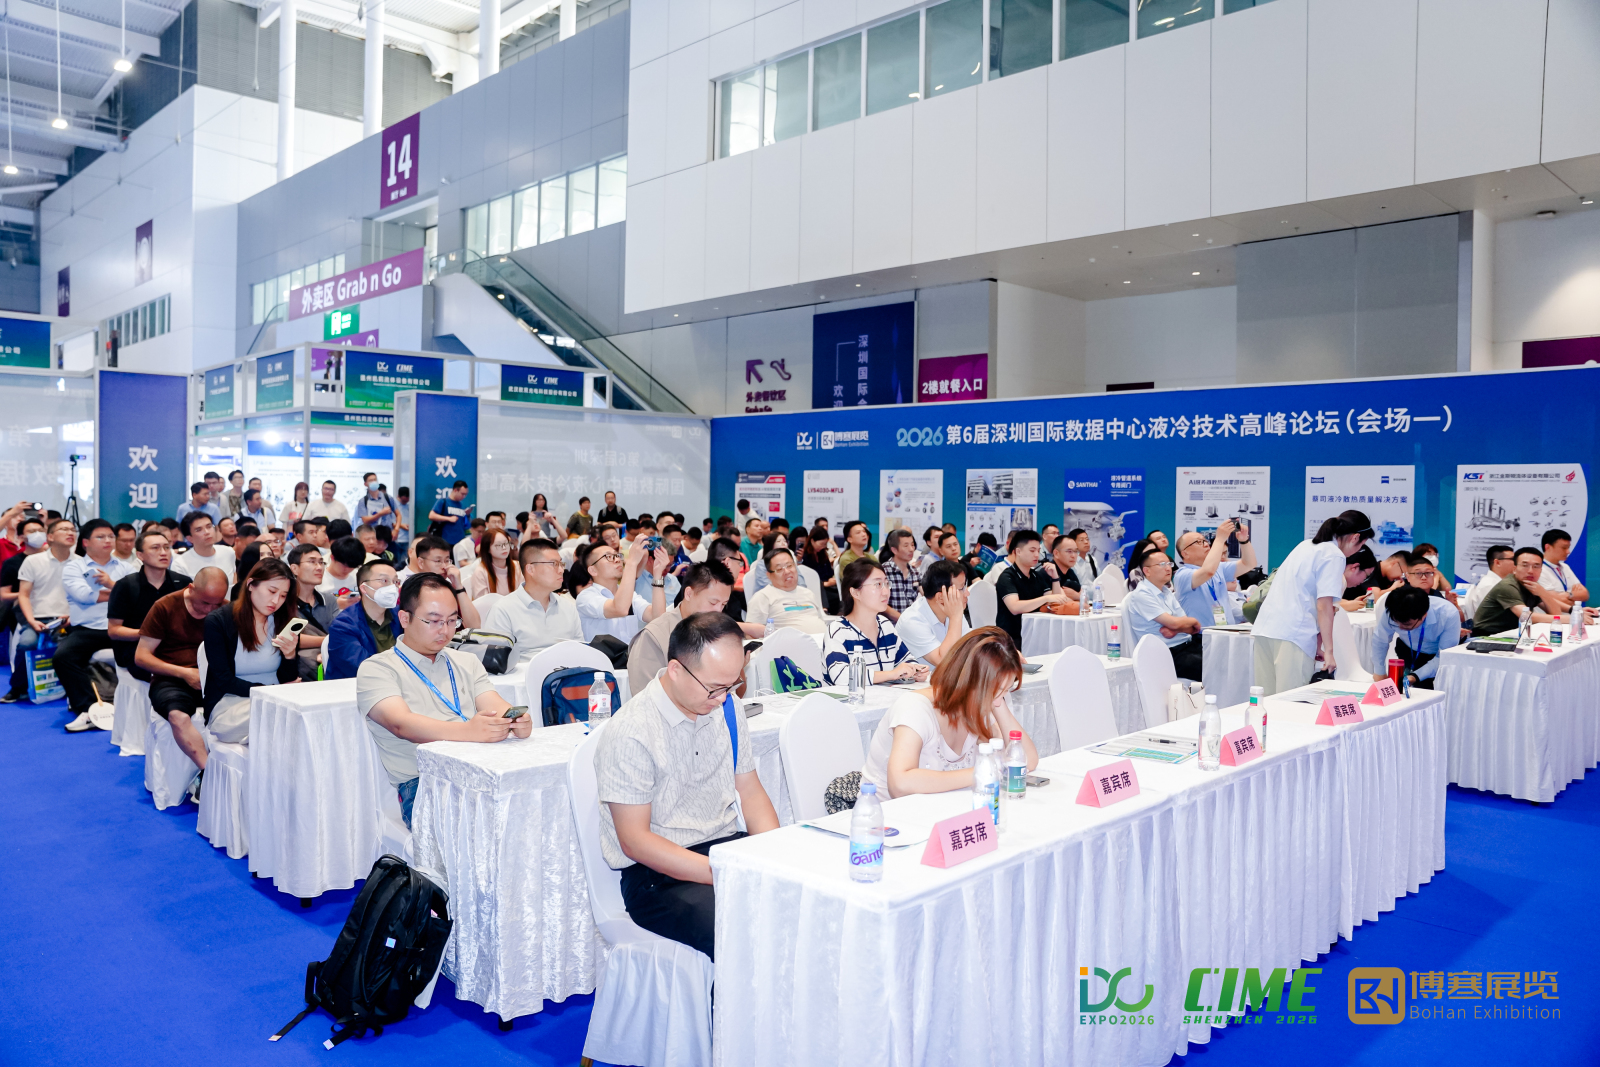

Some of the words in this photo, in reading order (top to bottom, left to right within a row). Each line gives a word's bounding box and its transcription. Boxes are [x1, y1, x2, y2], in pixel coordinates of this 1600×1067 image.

[387, 133, 412, 187] 14
[302, 281, 335, 314] 外卖区
[337, 271, 367, 301] Grab
[370, 273, 379, 292] n
[381, 263, 402, 288] Go
[922, 378, 983, 395] 2楼就餐入口
[896, 426, 944, 447] 2026
[128, 445, 158, 534] 欢迎
[1312, 495, 1408, 504] 蔡司液冷散热质量解决方案
[1234, 736, 1256, 756] 嘉宾席
[1100, 771, 1132, 795] 嘉宾席
[949, 821, 988, 852] 嘉宾席
